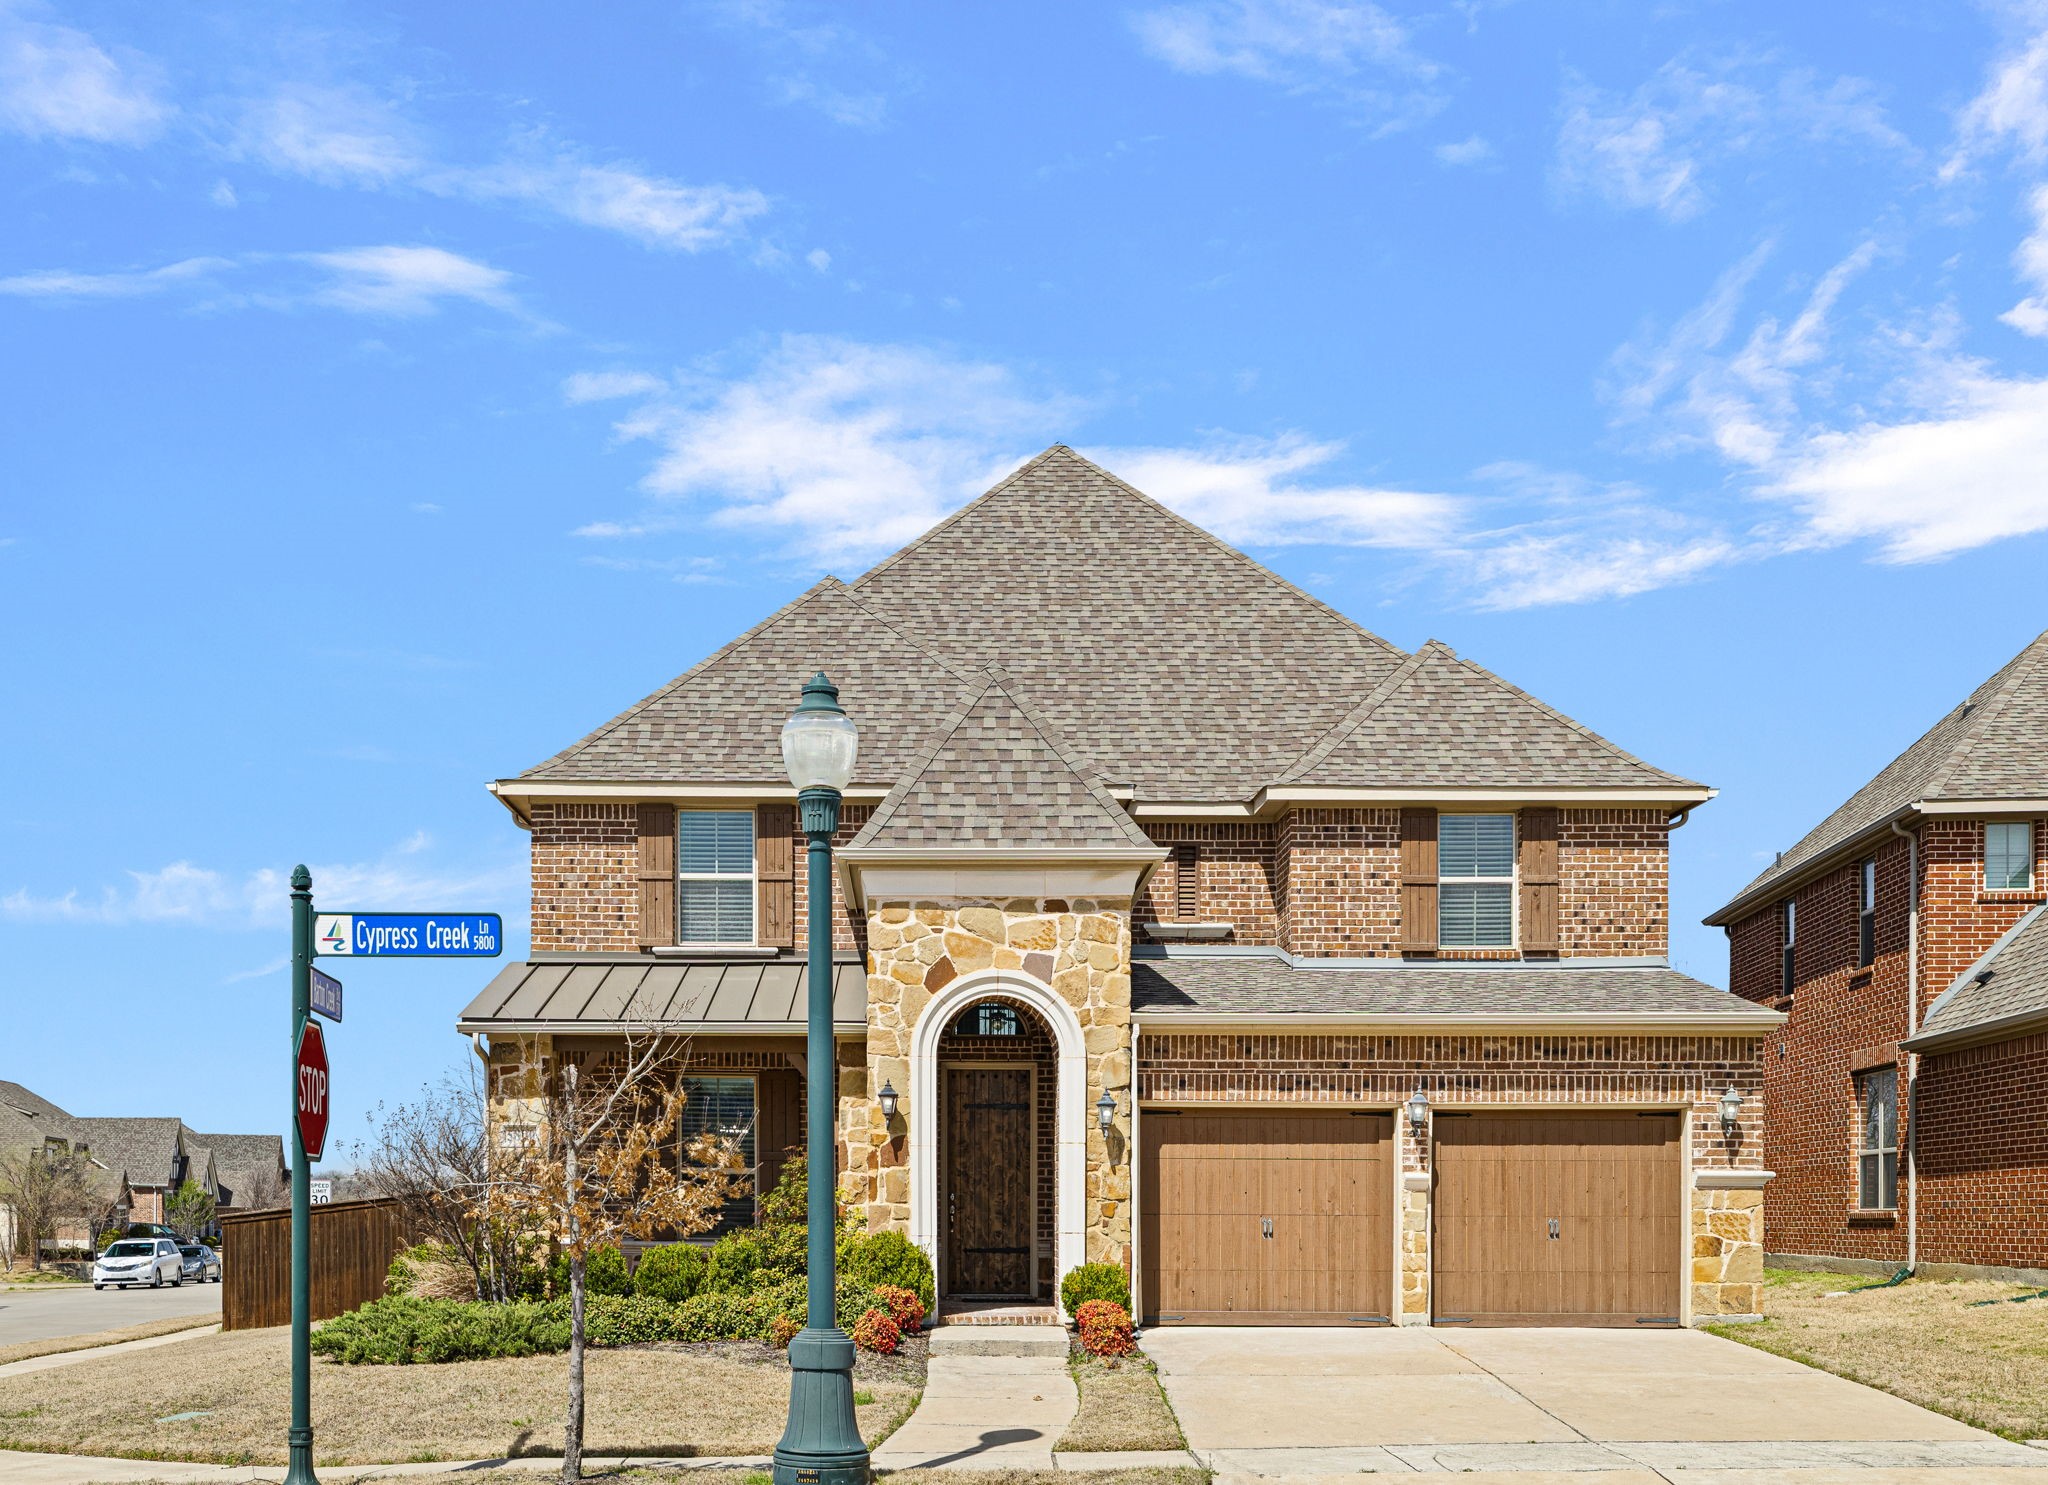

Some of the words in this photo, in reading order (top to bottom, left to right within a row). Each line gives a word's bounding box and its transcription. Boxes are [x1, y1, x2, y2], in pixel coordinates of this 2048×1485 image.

[356, 920, 418, 954] Cypress
[426, 920, 470, 949] Creek
[479, 919, 489, 935] Ln
[473, 935, 495, 950] 5800
[299, 1063, 326, 1115] STOP
[311, 1194, 329, 1204] 30
